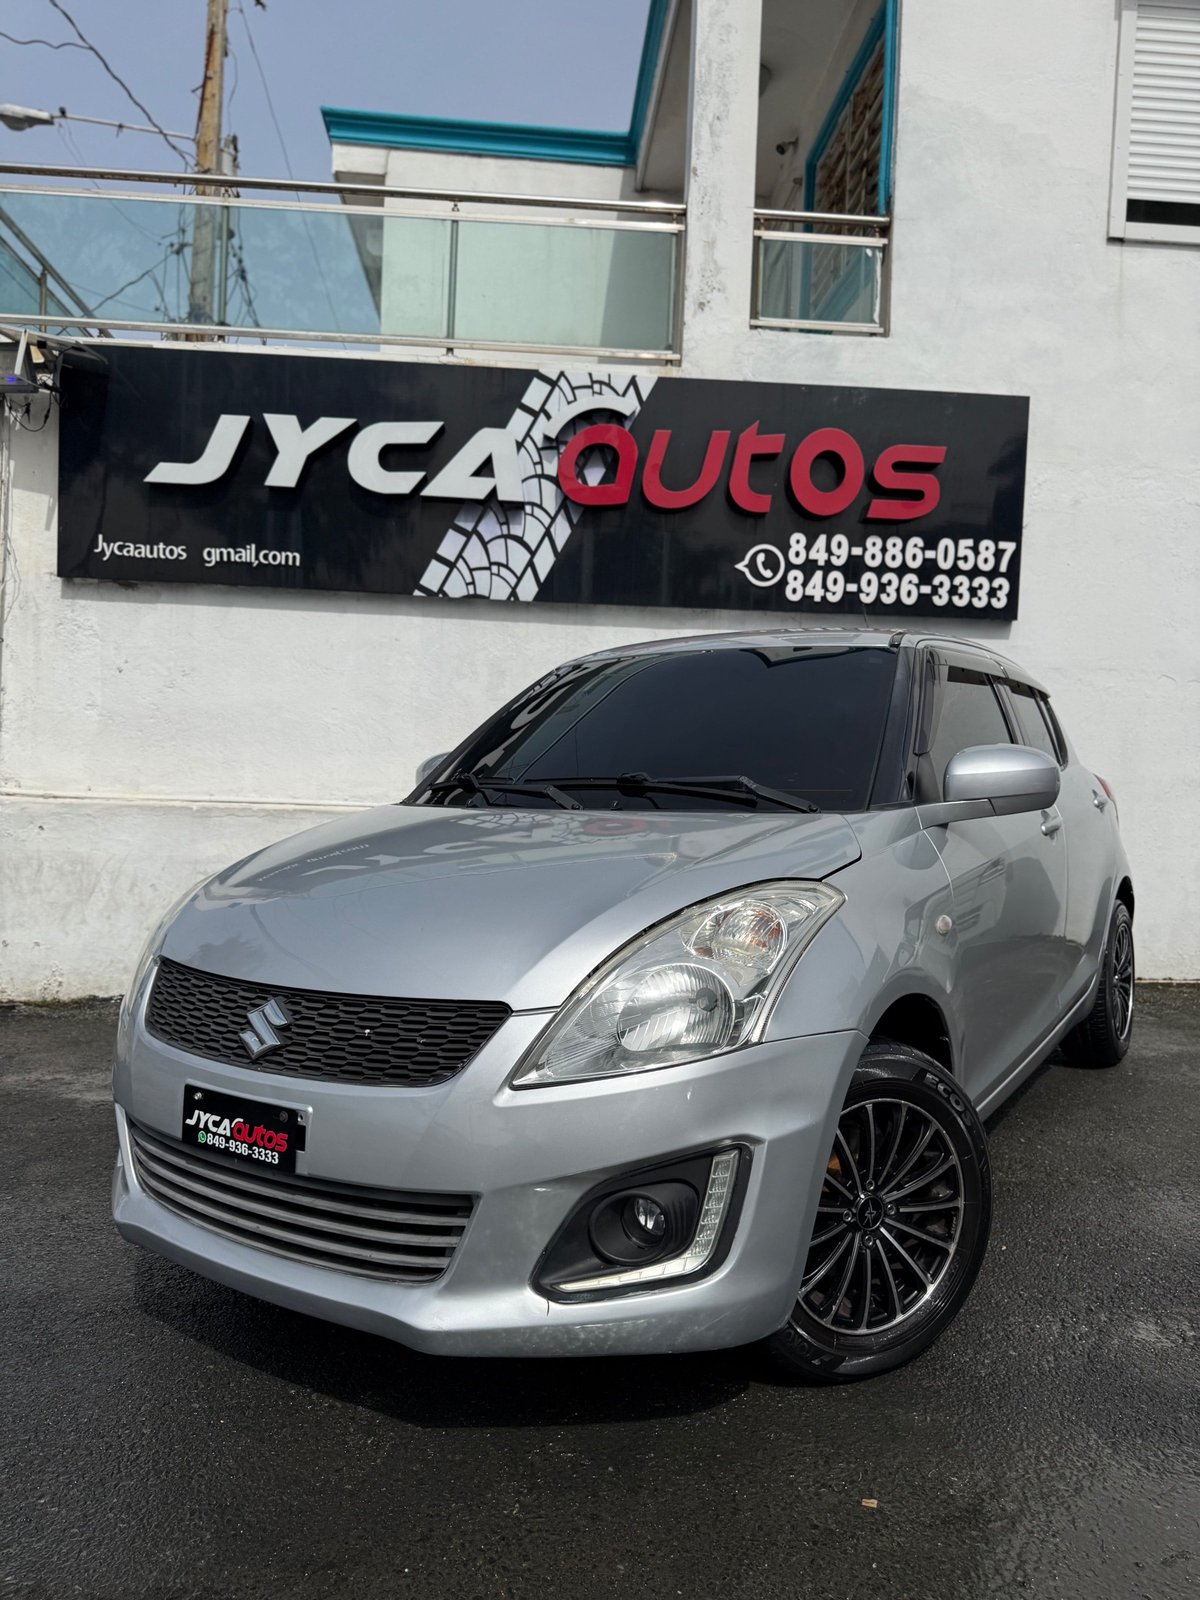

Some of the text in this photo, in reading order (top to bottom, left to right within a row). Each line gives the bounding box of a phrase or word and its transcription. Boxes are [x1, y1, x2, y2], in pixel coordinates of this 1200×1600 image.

[94, 533, 188, 561] Jycaautos
[787, 531, 1017, 573] 849-886-0587
[784, 569, 1011, 609] 849-936-3333
[207, 1133, 279, 1164] 849-936-3333
